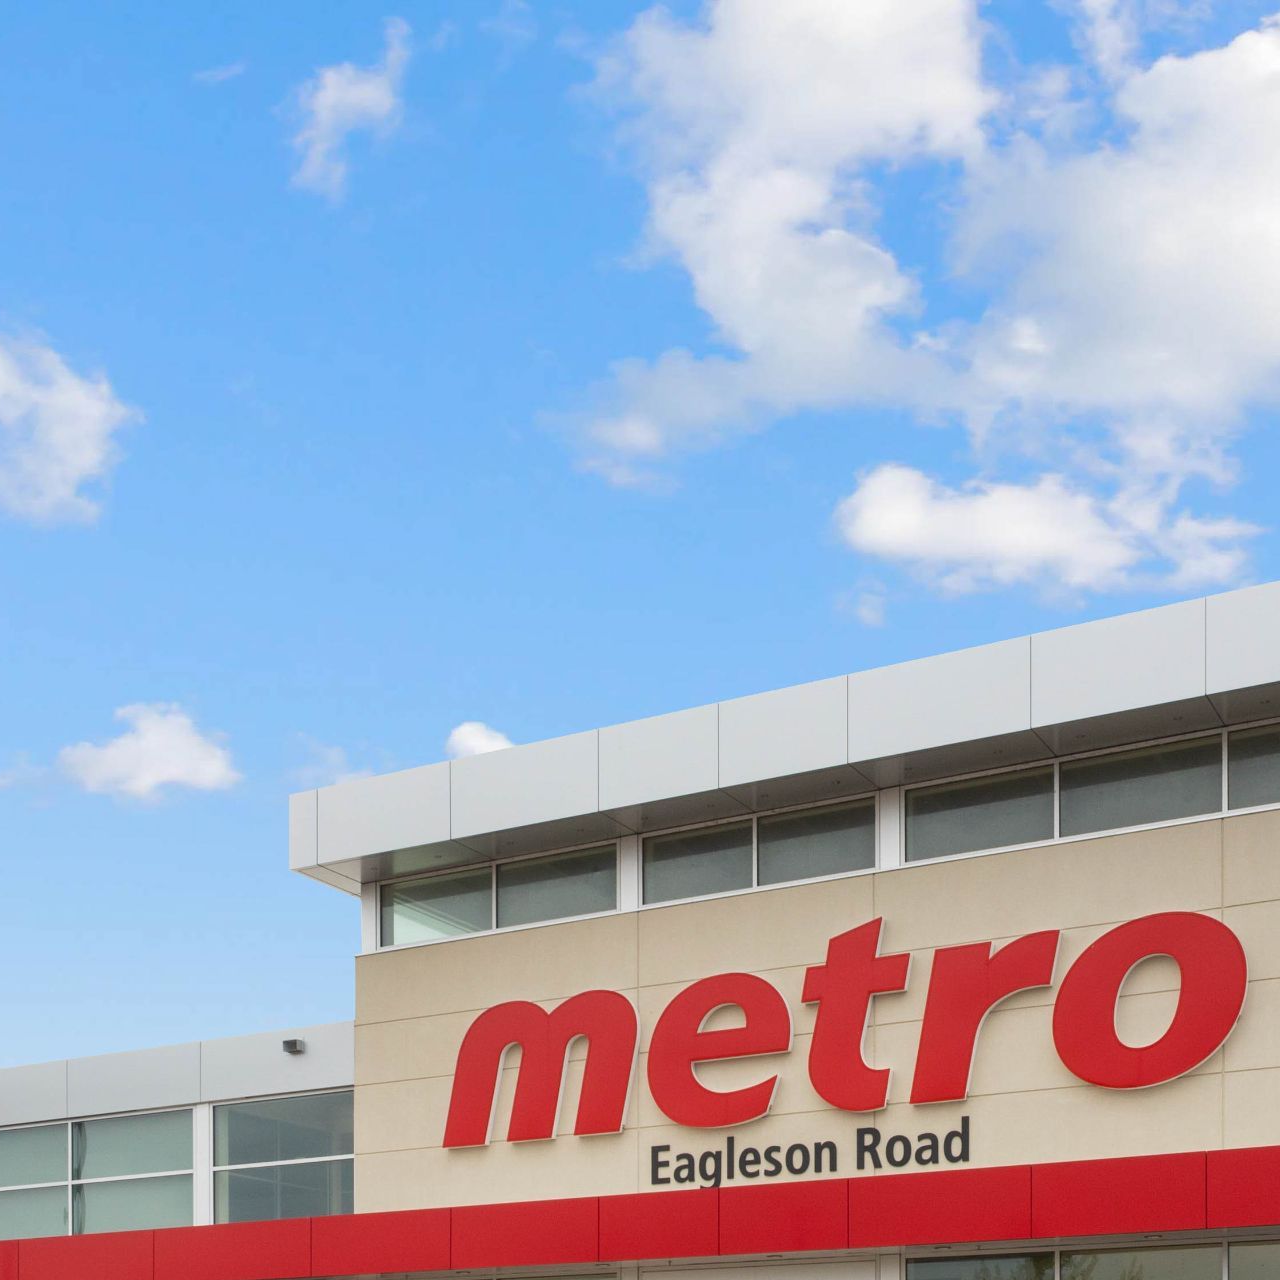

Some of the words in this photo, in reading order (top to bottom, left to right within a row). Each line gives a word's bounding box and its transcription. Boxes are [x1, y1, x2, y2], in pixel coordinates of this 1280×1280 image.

[443, 911, 1249, 1149] metro
[650, 1135, 838, 1189] Eagleson
[856, 1115, 971, 1169] Road
